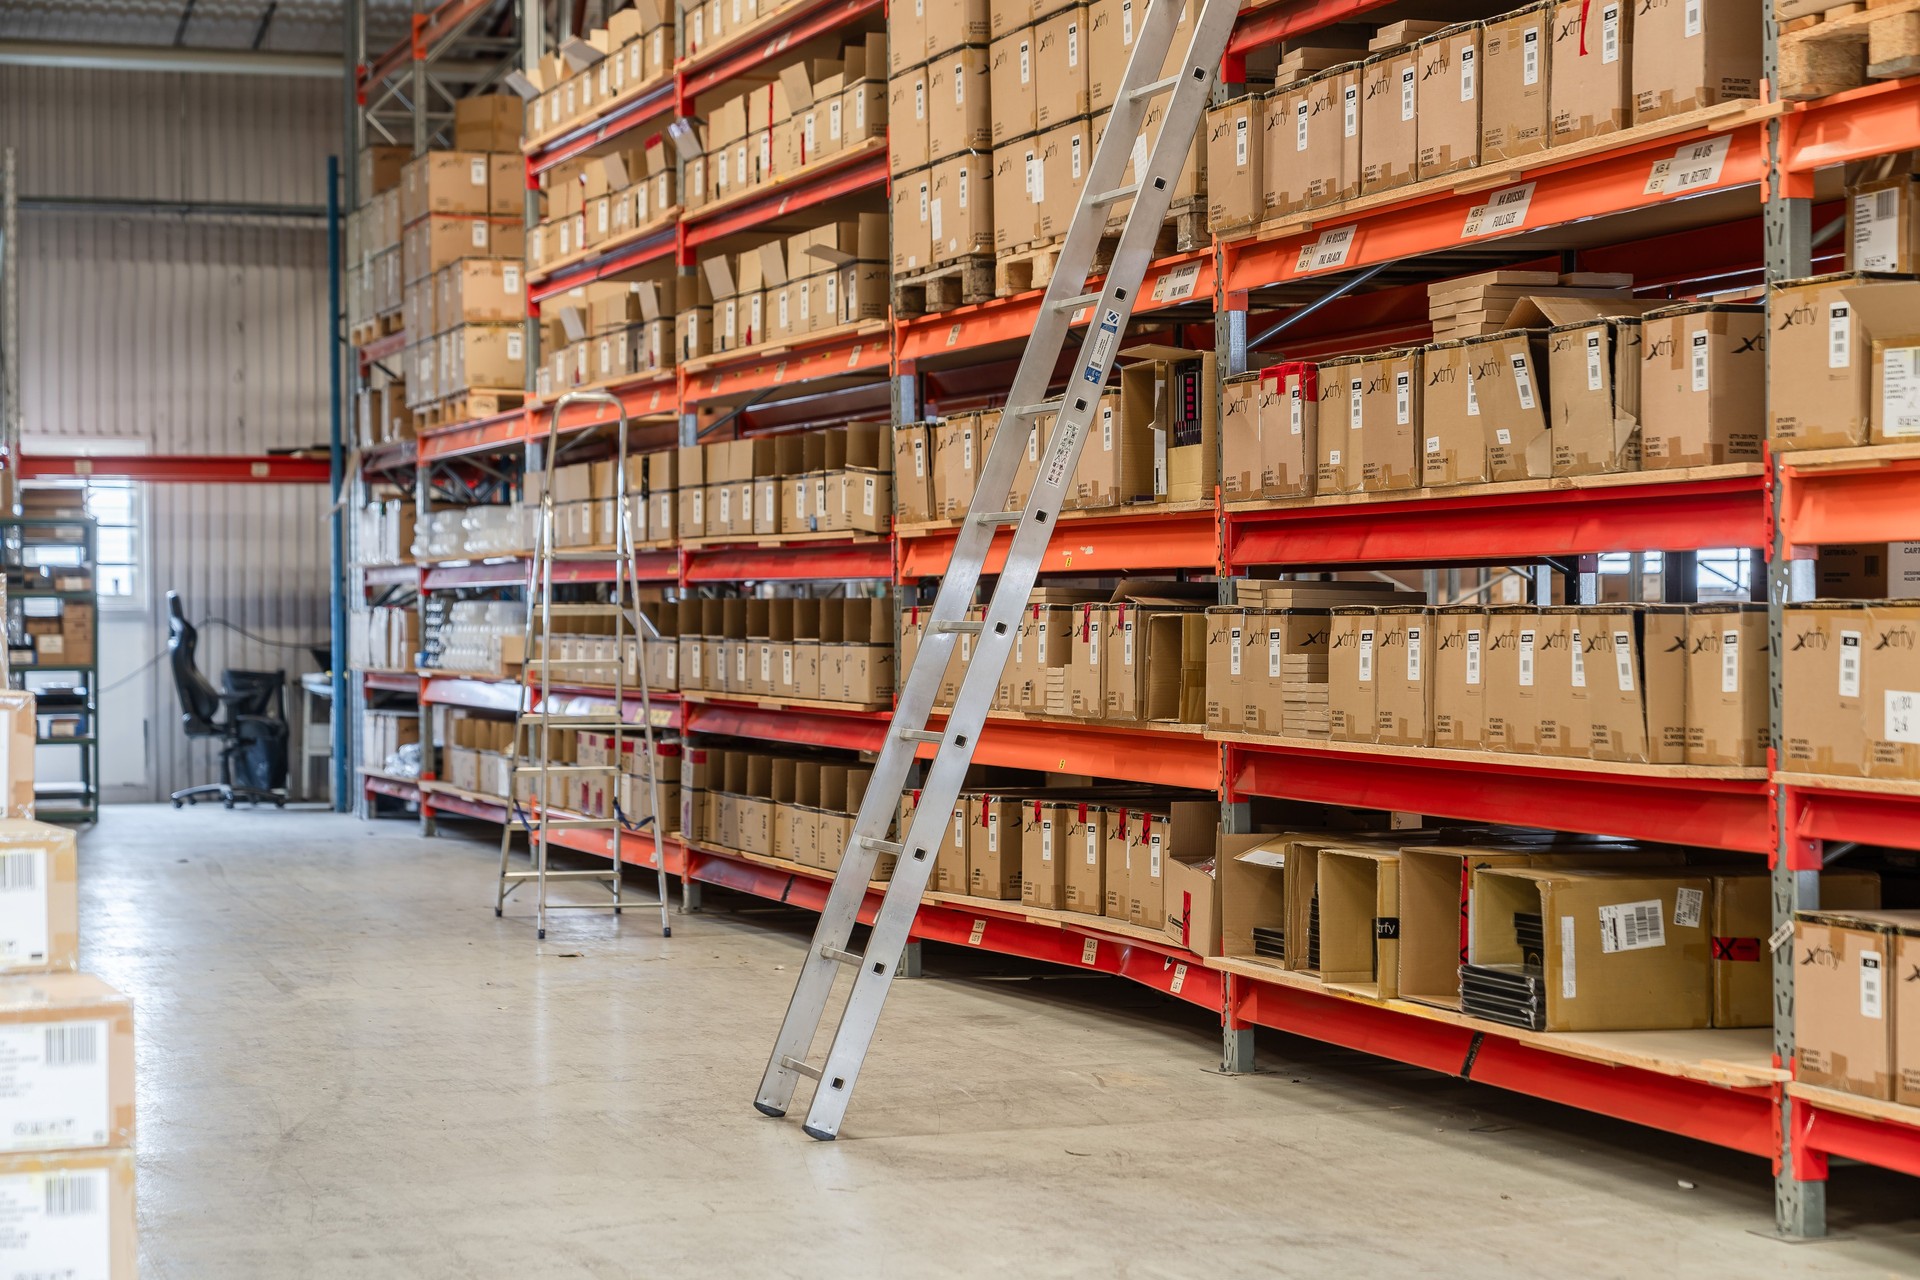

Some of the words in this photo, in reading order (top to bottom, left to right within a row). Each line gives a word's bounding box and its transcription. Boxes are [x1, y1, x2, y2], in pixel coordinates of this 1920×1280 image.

[1505, 188, 1526, 204] RUSSIA
[1471, 208, 1479, 218] KB
[1492, 211, 1517, 228] FULLSIZE
[1466, 224, 1474, 234] KB
[1332, 231, 1349, 244] RUSSIA
[1326, 251, 1342, 264] BLACK
